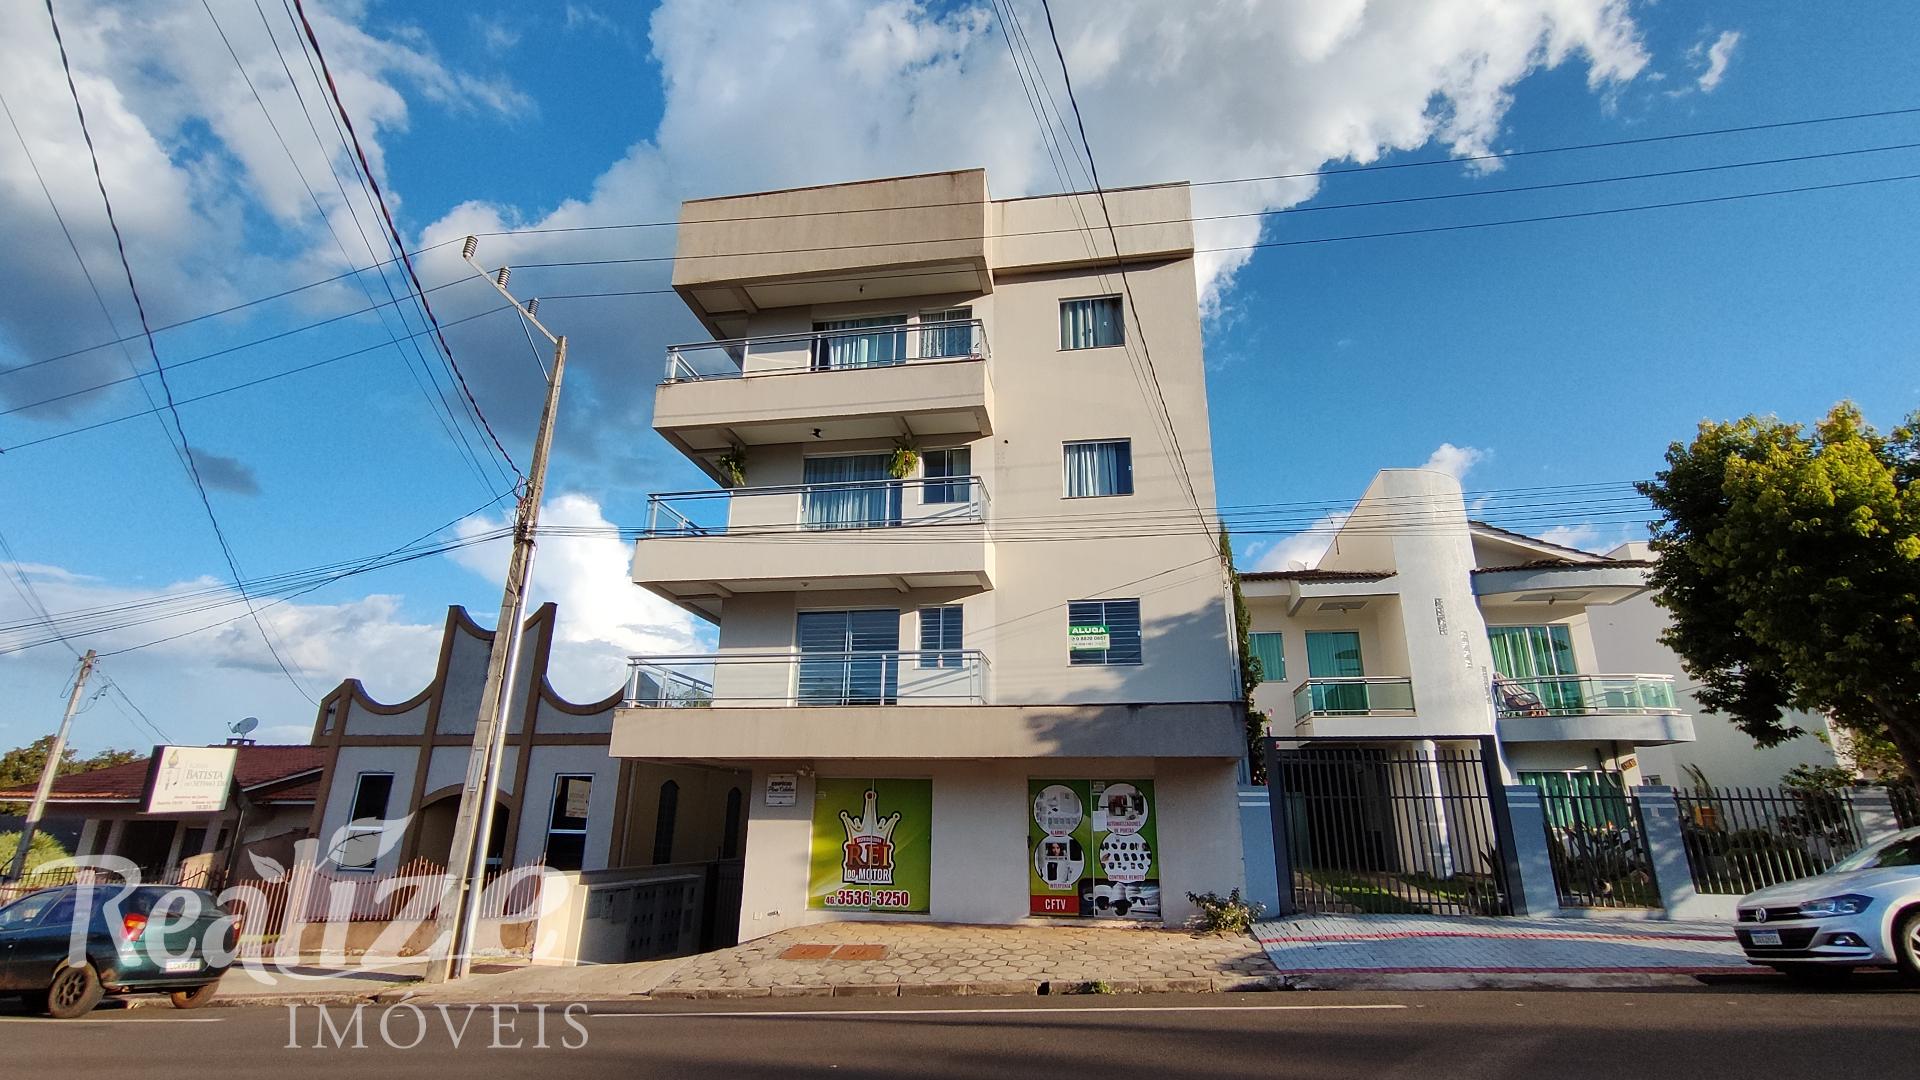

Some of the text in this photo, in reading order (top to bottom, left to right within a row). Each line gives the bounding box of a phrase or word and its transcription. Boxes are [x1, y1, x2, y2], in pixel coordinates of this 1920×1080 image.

[1072, 626, 1106, 634] ALUGA
[185, 769, 224, 780] BATISTA
[846, 844, 890, 867] REI
[847, 868, 889, 881] DO MOTOR
[837, 890, 910, 906] 3536-3250
[1045, 898, 1066, 910] CFTV
